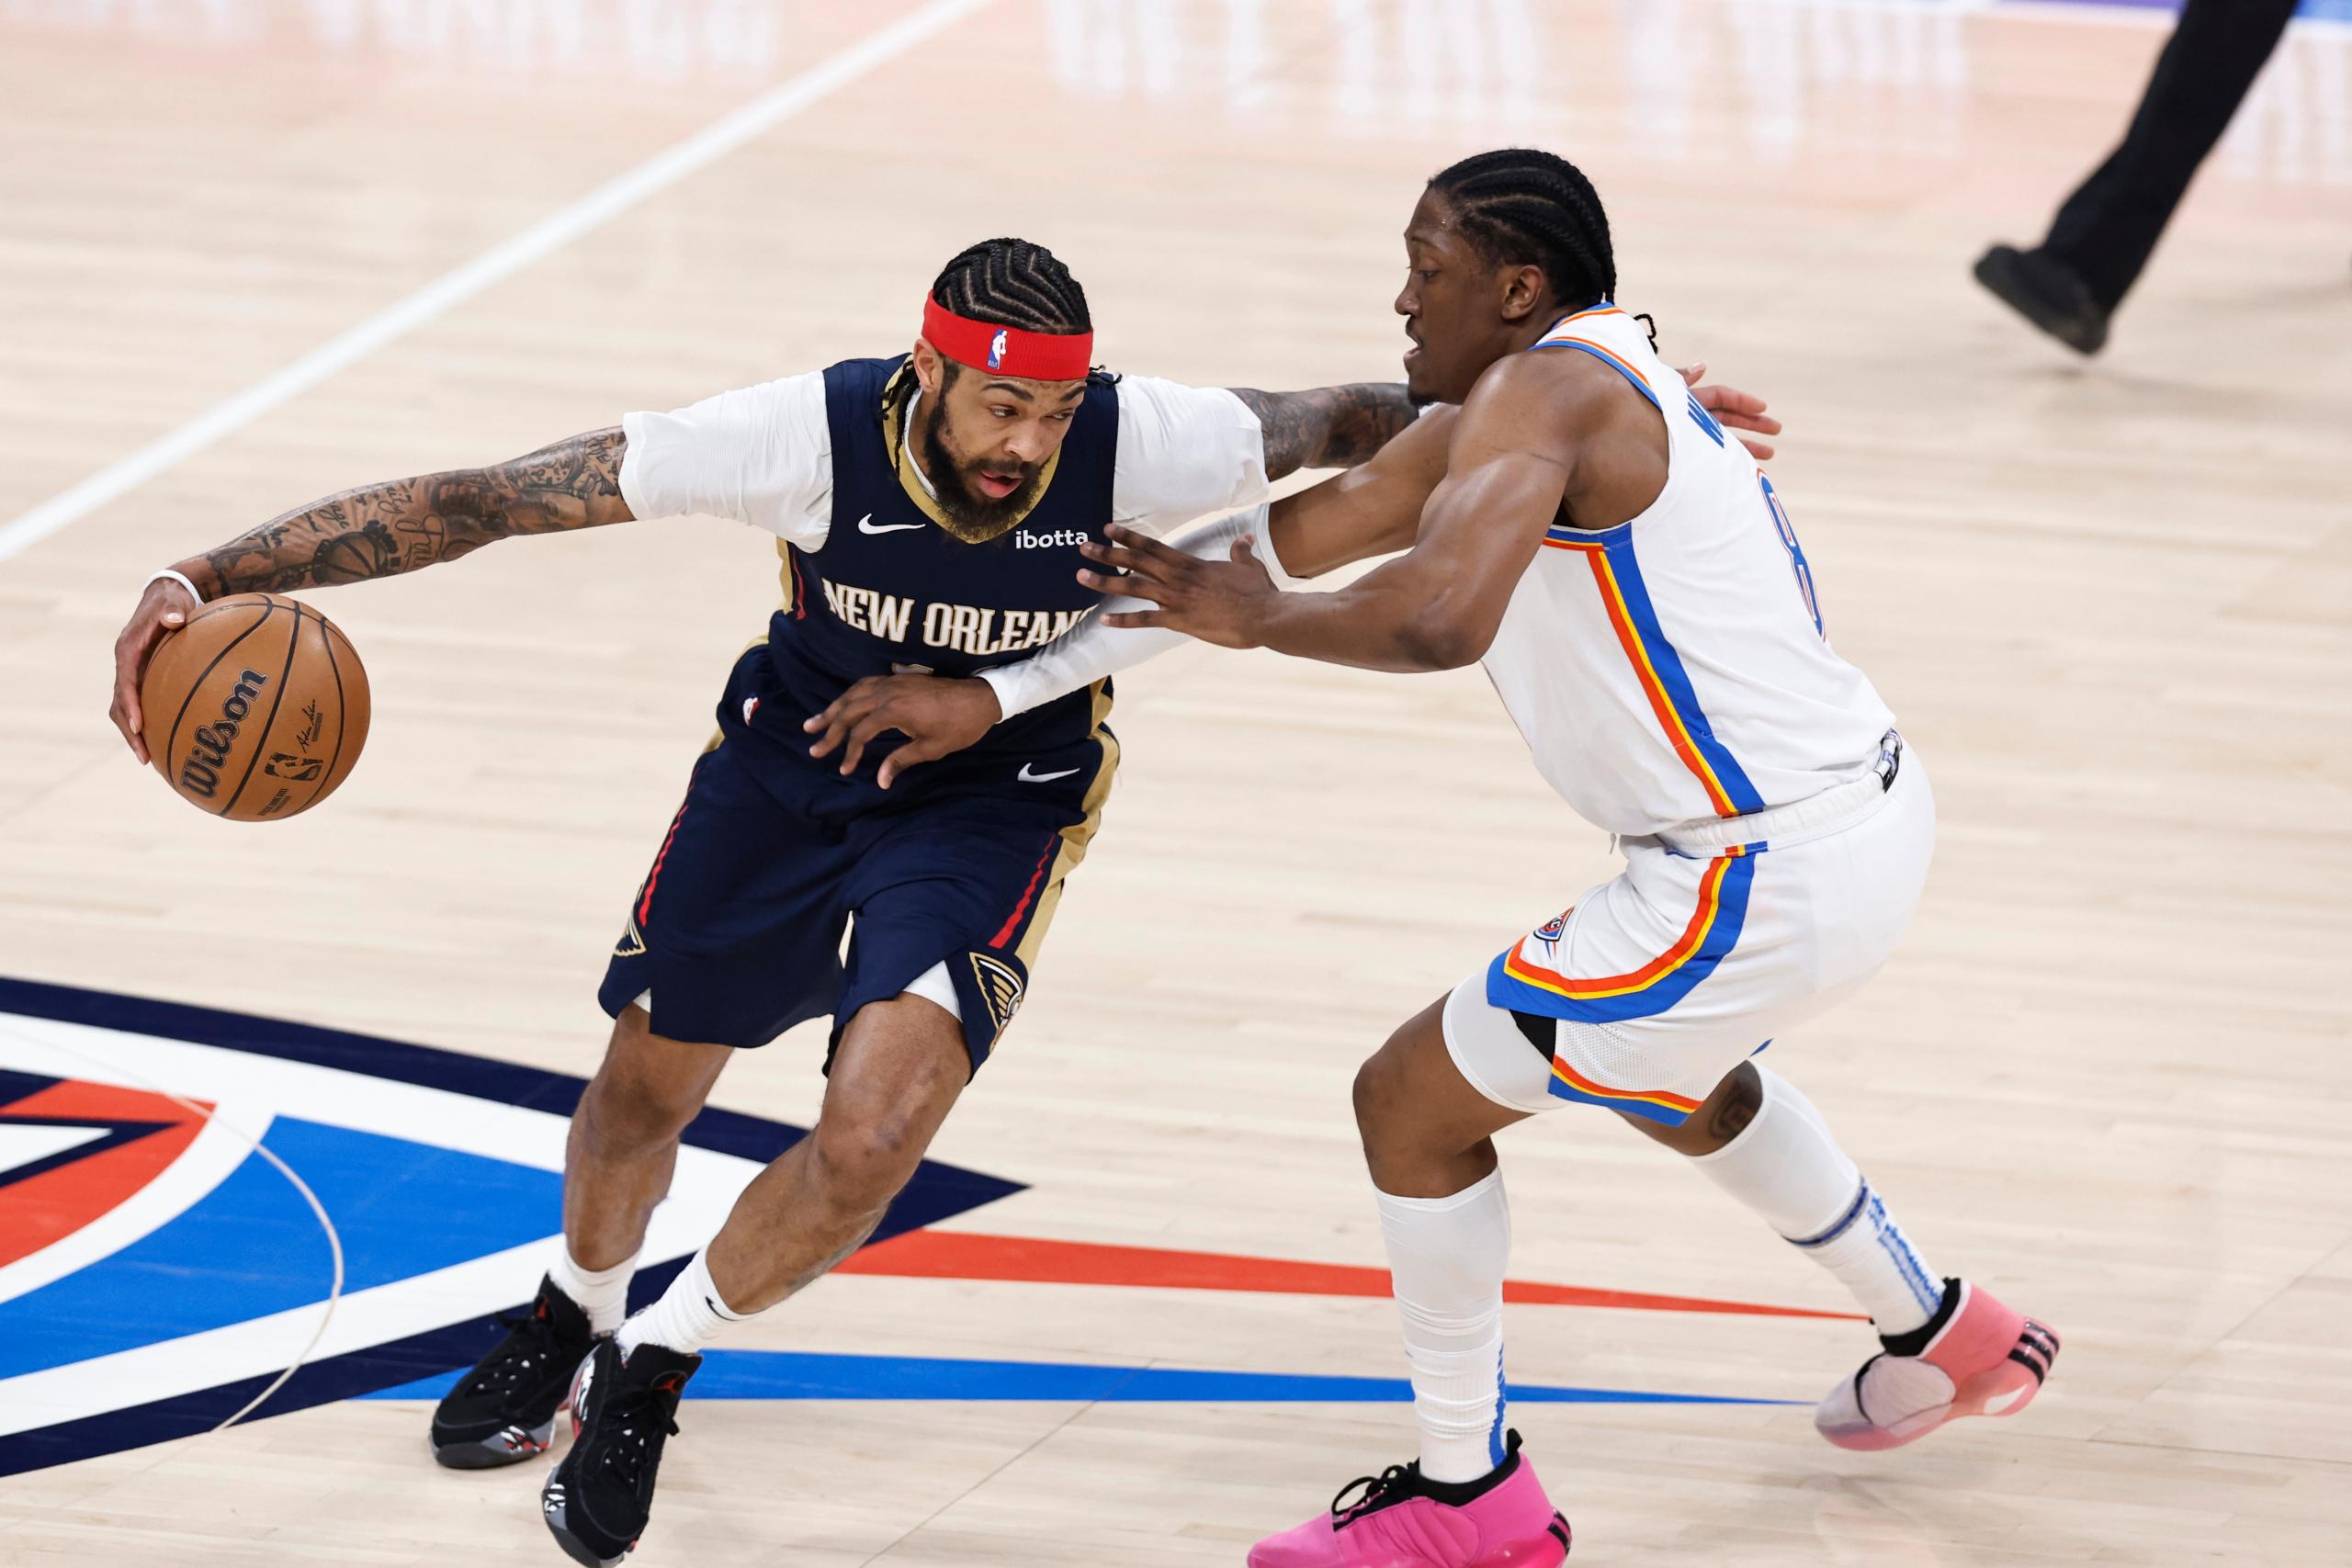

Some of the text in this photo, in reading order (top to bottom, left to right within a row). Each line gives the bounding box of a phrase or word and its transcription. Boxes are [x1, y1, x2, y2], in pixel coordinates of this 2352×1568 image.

[1015, 529, 1089, 549] ibotta
[821, 577, 1100, 656] NEW ORLEAN
[180, 668, 270, 798] Wilson
